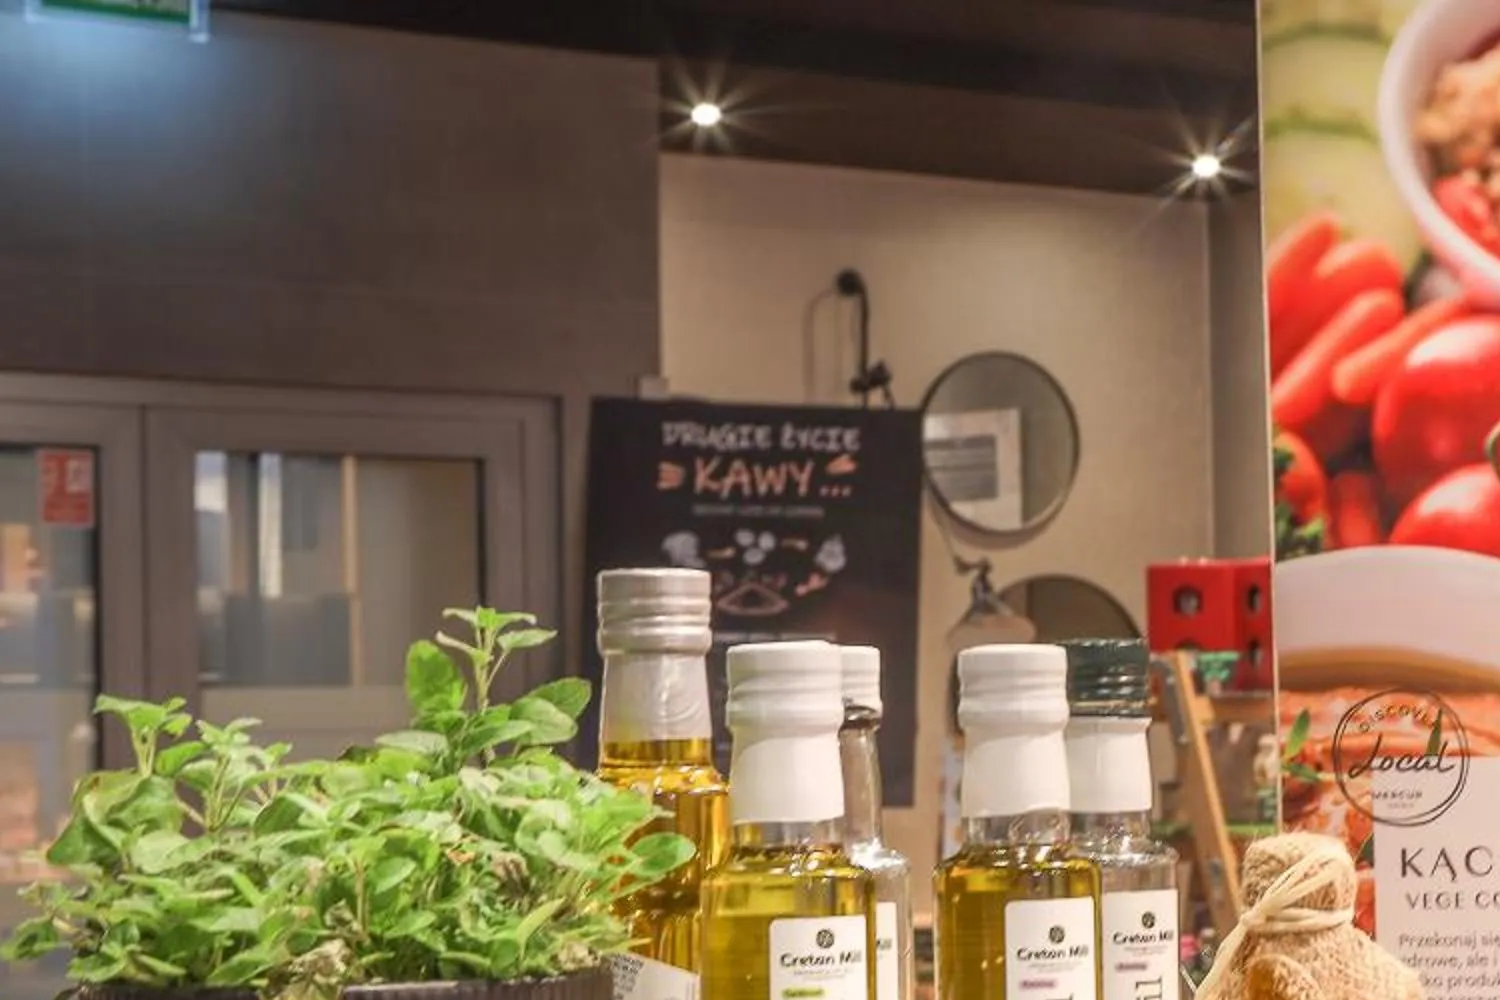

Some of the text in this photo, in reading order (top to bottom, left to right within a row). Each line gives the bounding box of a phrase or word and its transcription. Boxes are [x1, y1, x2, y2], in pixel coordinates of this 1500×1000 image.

[1359, 703, 1437, 733] DISCOVE
[1348, 733, 1455, 779] Local
[1406, 891, 1465, 911] VEGE
